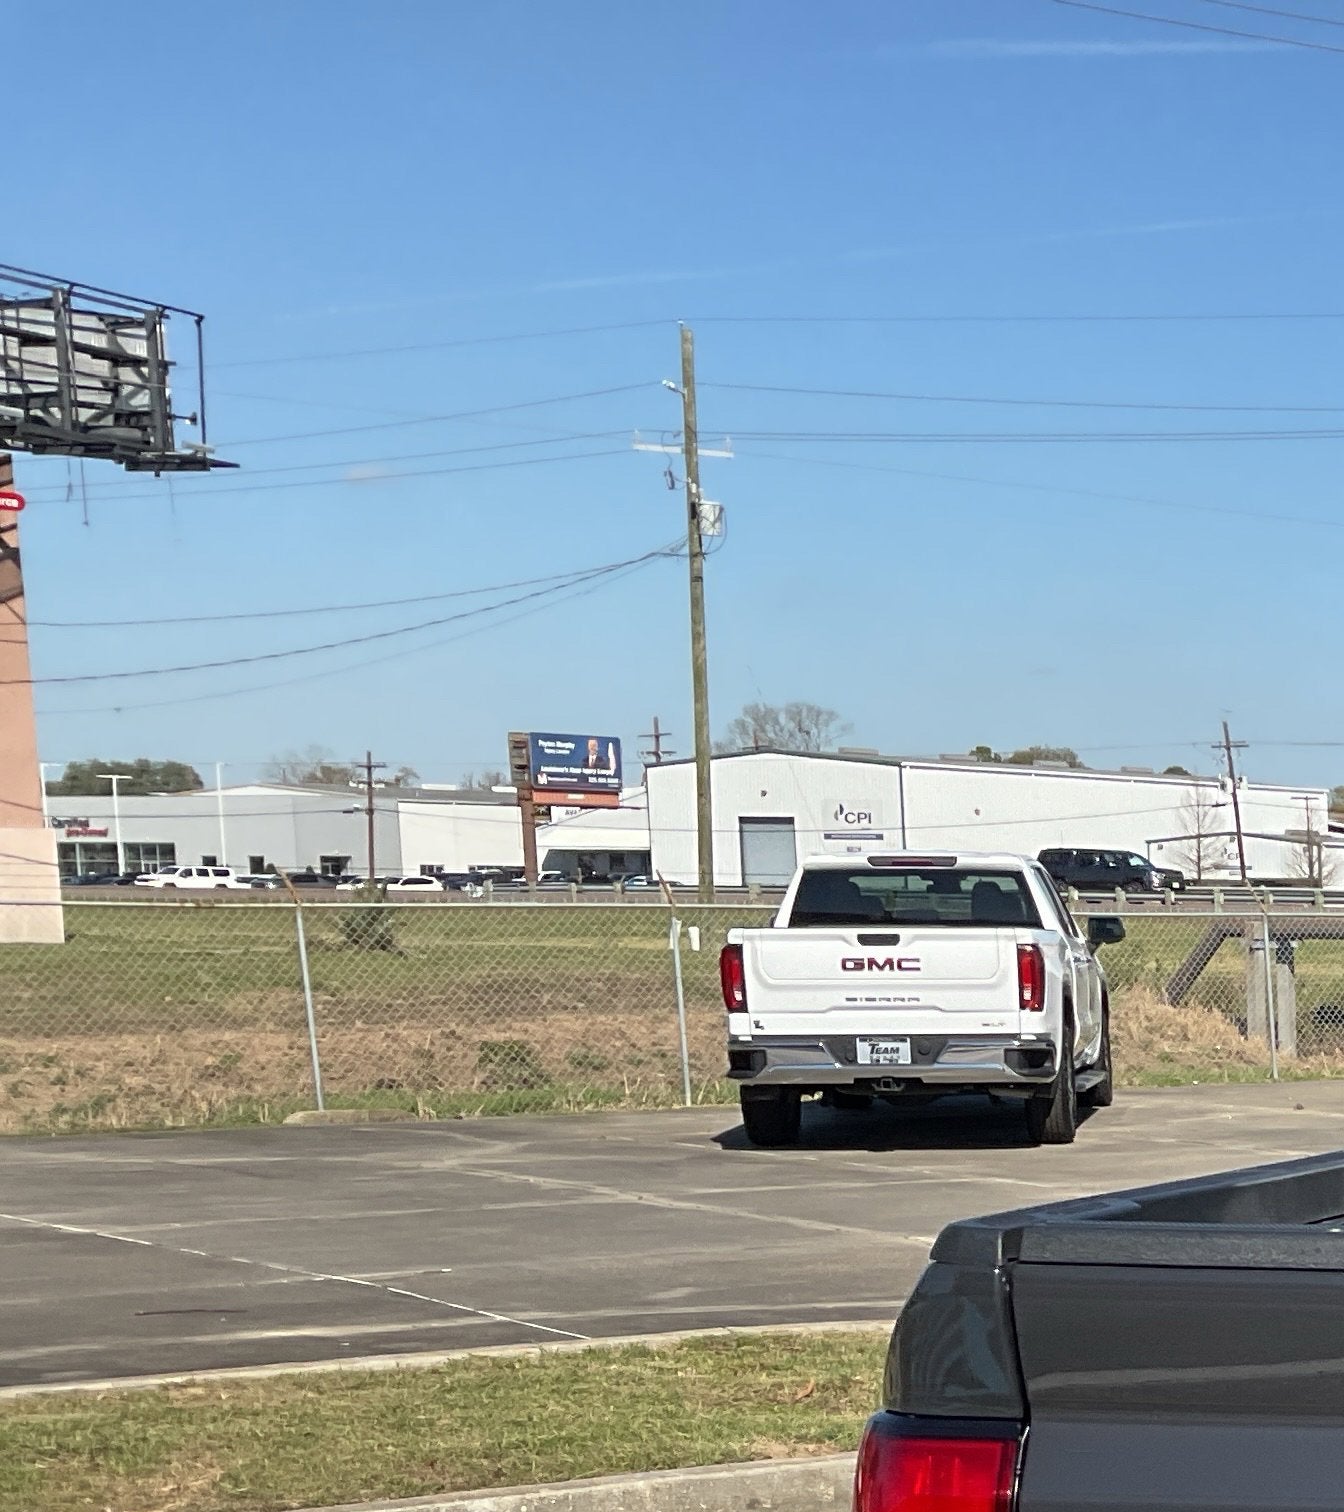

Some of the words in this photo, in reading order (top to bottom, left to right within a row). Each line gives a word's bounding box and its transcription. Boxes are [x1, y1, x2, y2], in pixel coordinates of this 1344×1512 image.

[844, 812, 872, 824] CPI
[841, 957, 922, 972] GMC
[868, 1043, 900, 1055] TEAM
